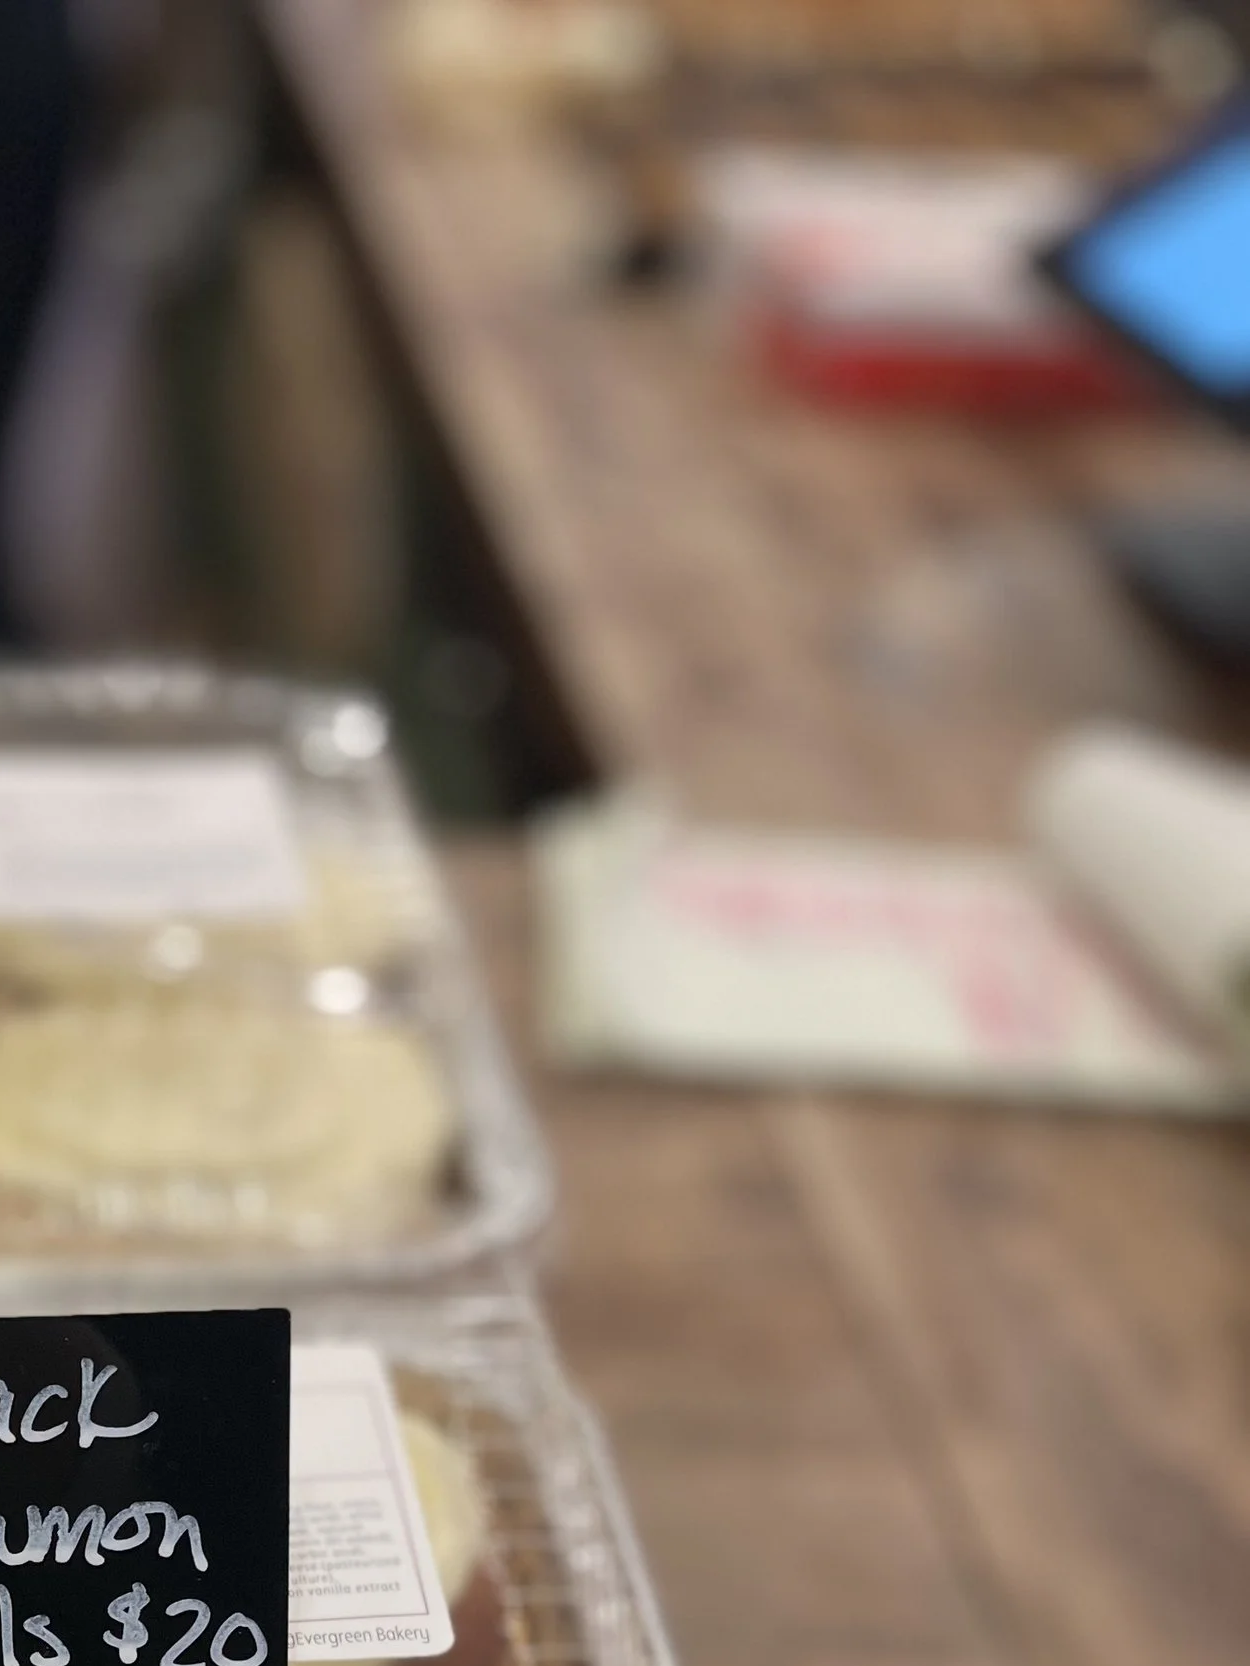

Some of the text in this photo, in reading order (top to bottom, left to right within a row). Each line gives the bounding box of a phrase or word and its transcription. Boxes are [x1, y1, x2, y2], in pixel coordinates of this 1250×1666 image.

[307, 1583, 352, 1596] vanilla
[354, 1580, 402, 1594] extract
[375, 1625, 431, 1644] Bakery
